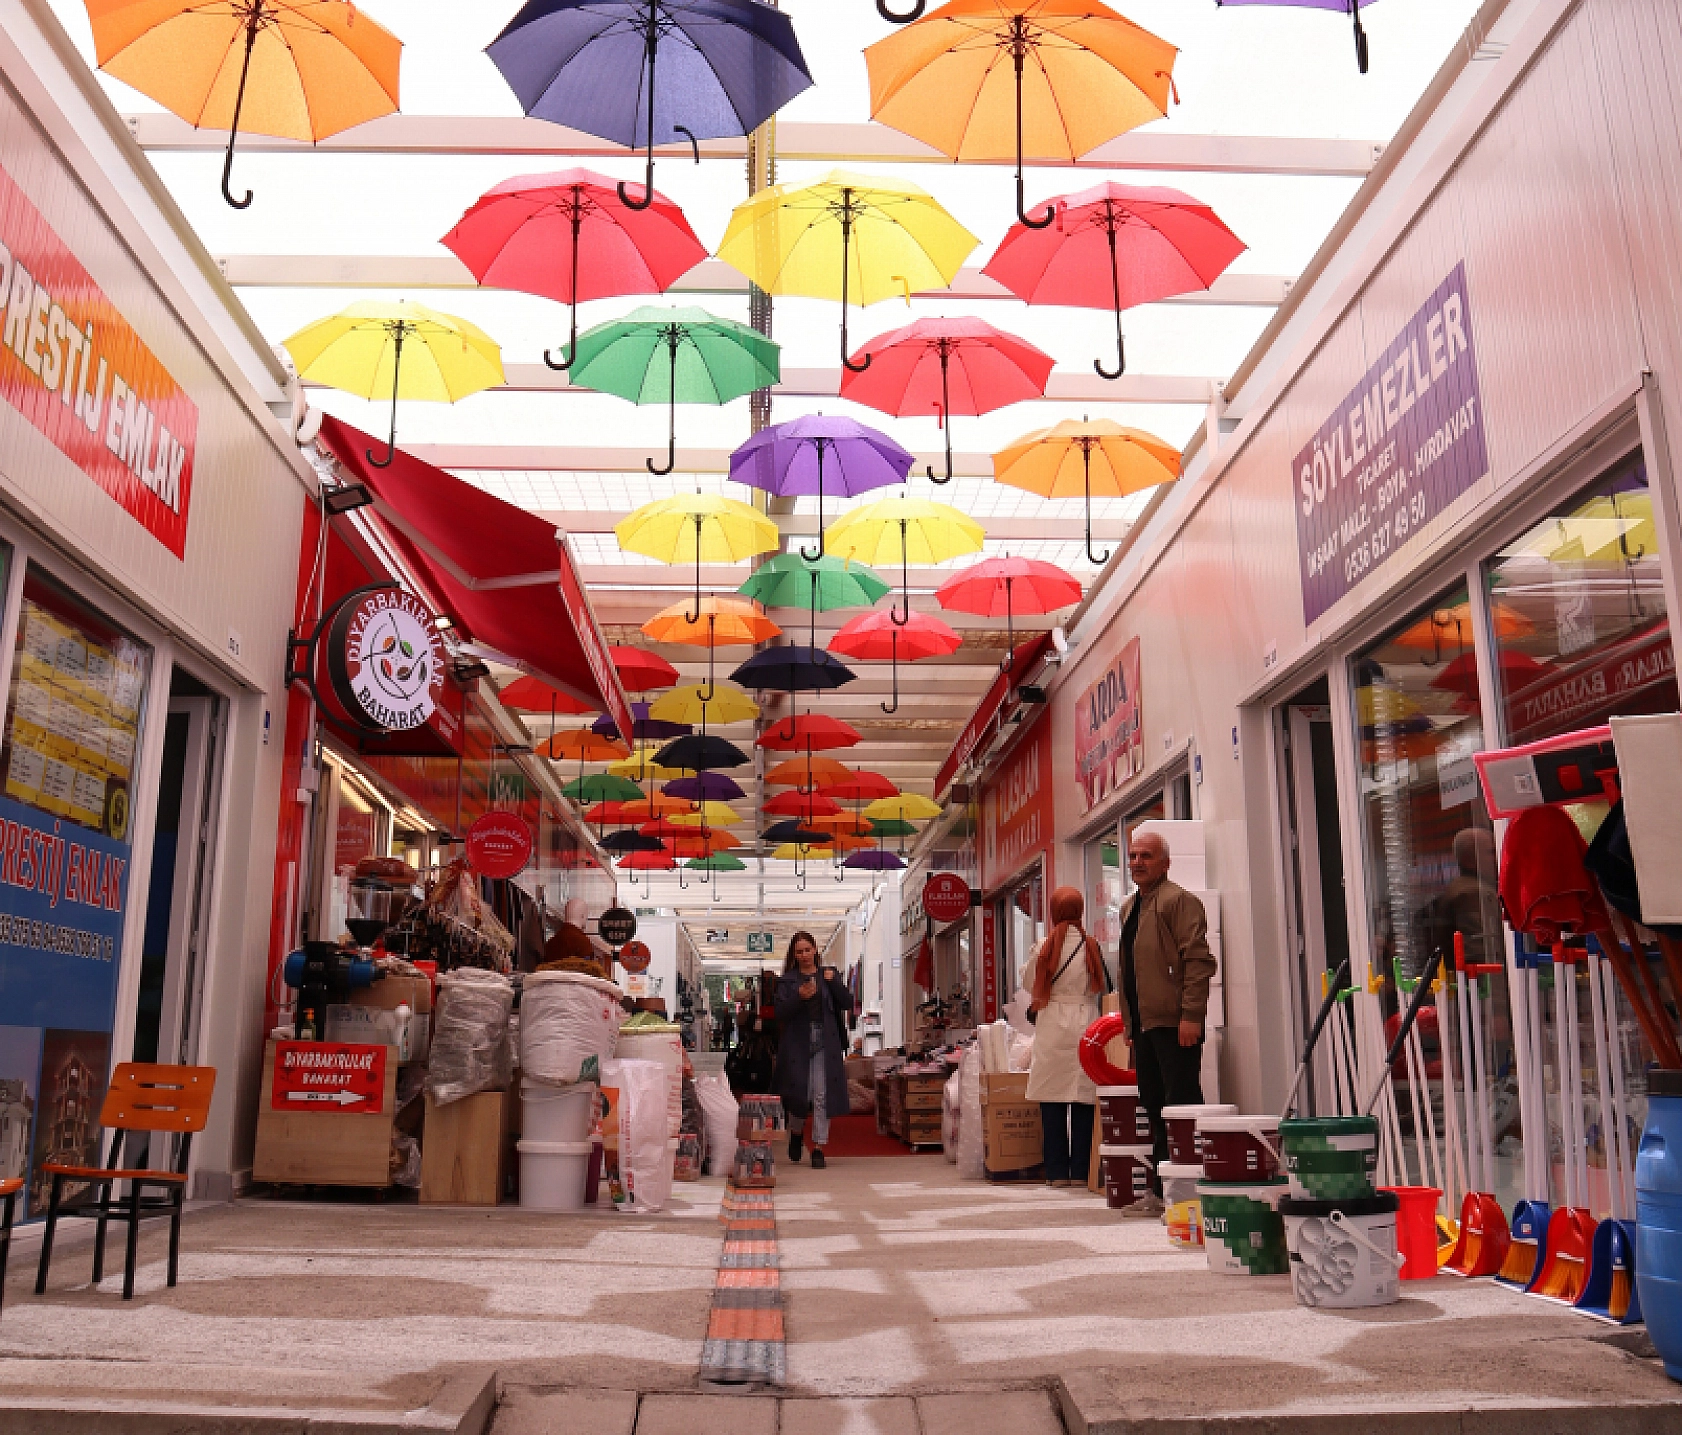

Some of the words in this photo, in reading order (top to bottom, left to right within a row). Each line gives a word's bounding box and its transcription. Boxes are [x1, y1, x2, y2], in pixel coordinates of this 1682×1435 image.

[1301, 292, 1468, 518] SÖYLEMEZLER
[106, 371, 186, 516] EMLAK
[1357, 440, 1397, 494] TİCARET
[1378, 467, 1409, 511] BOYA
[1415, 397, 1477, 477] HIRDAVAT
[357, 685, 428, 729] BAHARAT
[1089, 660, 1128, 736] ARDA
[65, 841, 126, 913] EMLAK
[302, 1072, 352, 1086] BAHARAT
